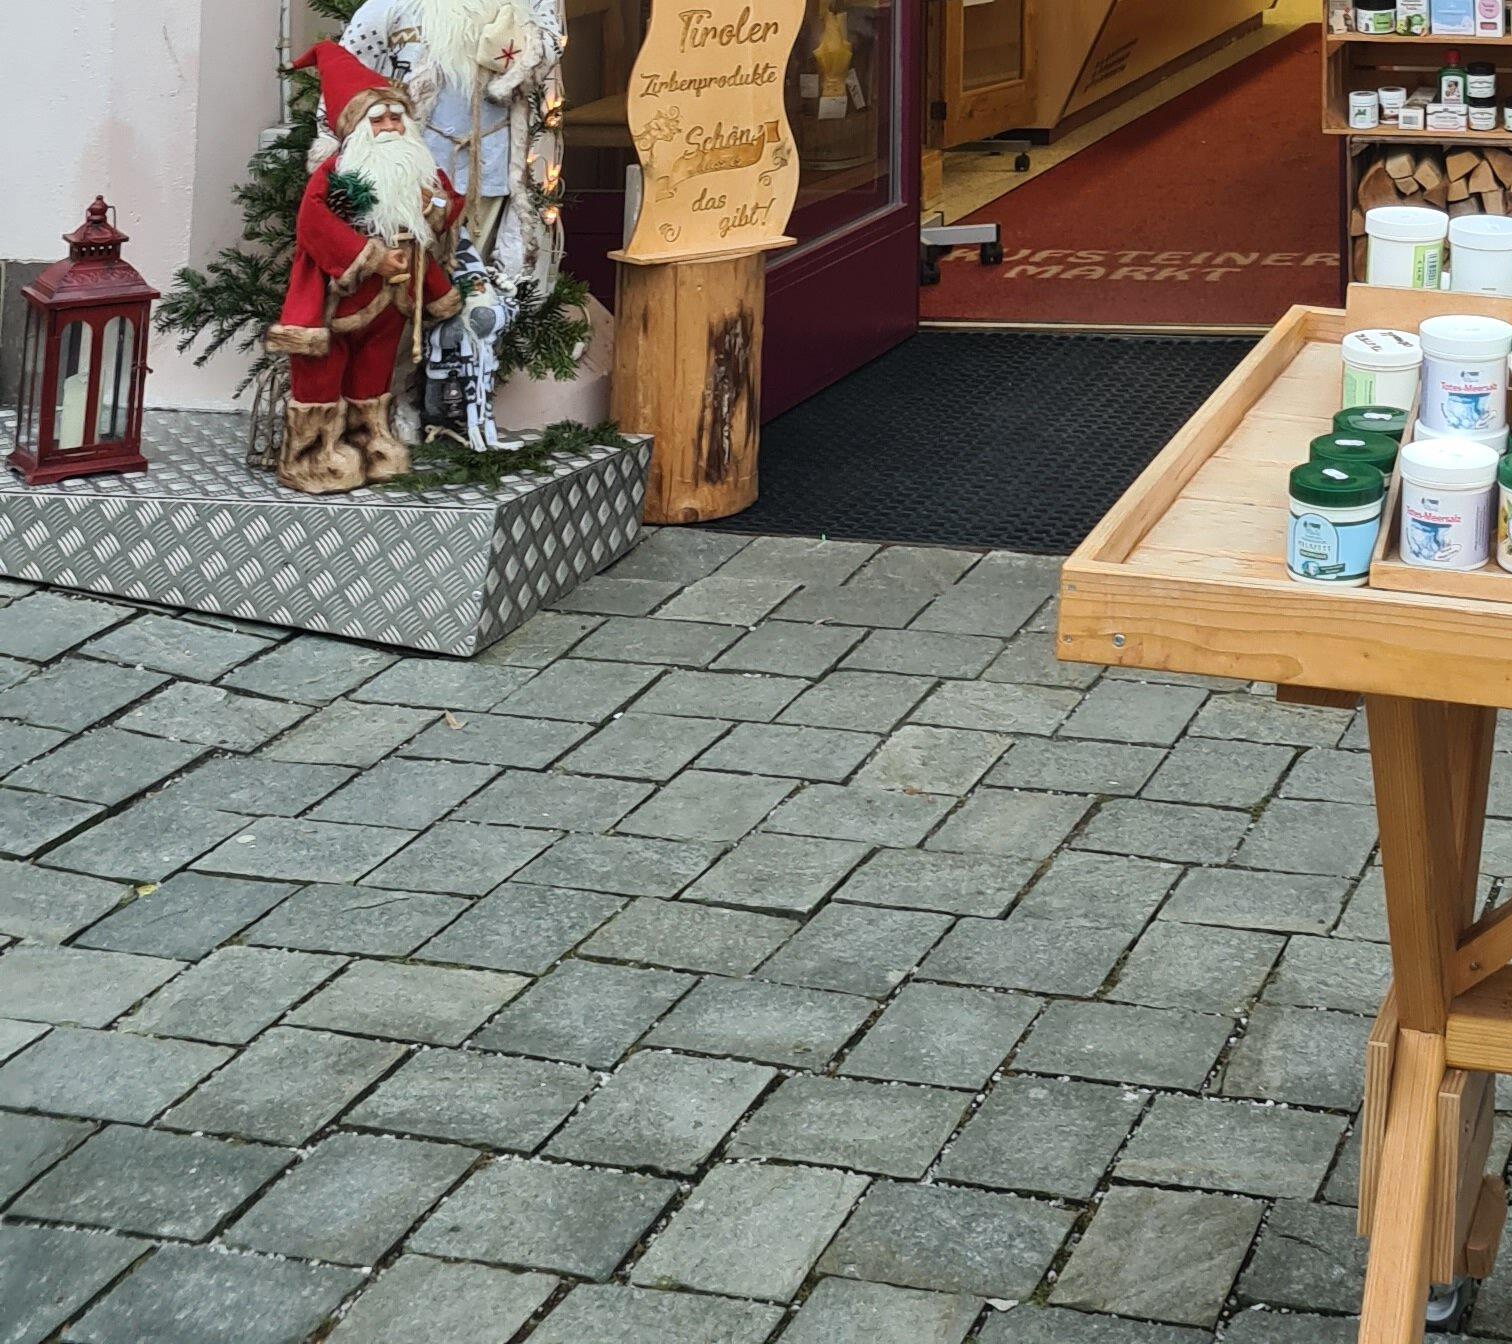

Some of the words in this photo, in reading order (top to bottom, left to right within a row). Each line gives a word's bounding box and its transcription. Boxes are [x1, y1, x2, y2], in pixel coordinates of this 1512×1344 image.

[678, 6, 779, 54] Tiroler
[640, 63, 777, 98] Zirbenprodukte
[691, 188, 727, 212] das
[719, 197, 776, 238] gibt!
[1002, 265, 1241, 283] MARKT
